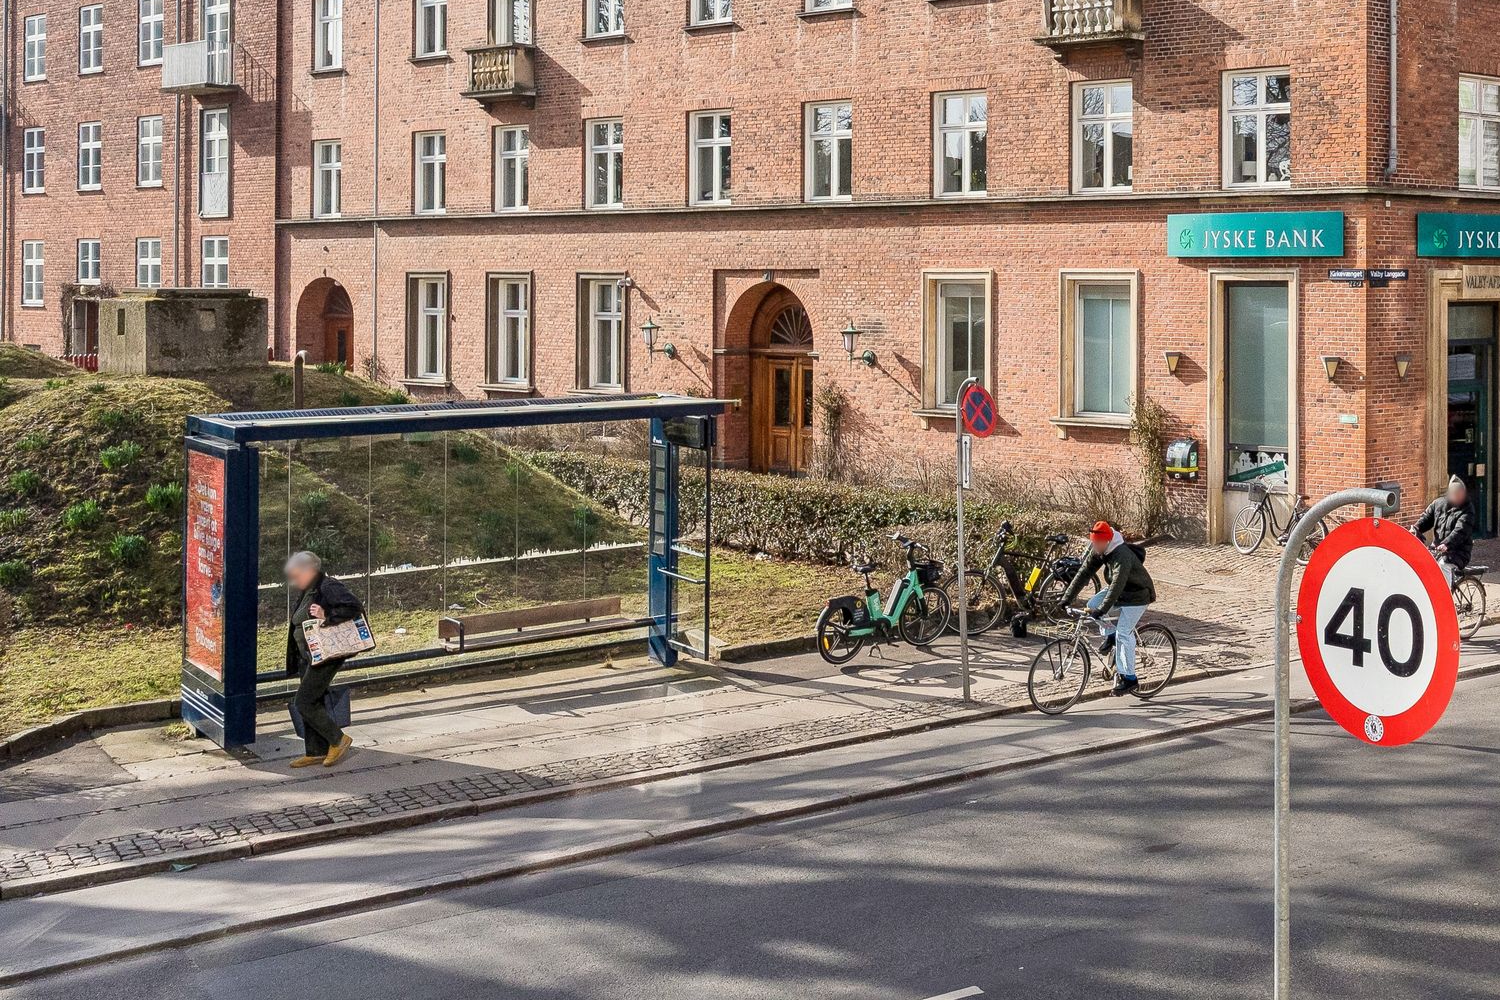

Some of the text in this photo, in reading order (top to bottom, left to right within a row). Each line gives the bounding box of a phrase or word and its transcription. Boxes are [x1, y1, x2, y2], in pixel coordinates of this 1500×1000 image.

[1203, 229, 1325, 249] JYSKE BANK
[1370, 270, 1406, 279] Valby Langgade
[1324, 586, 1425, 678] 40
